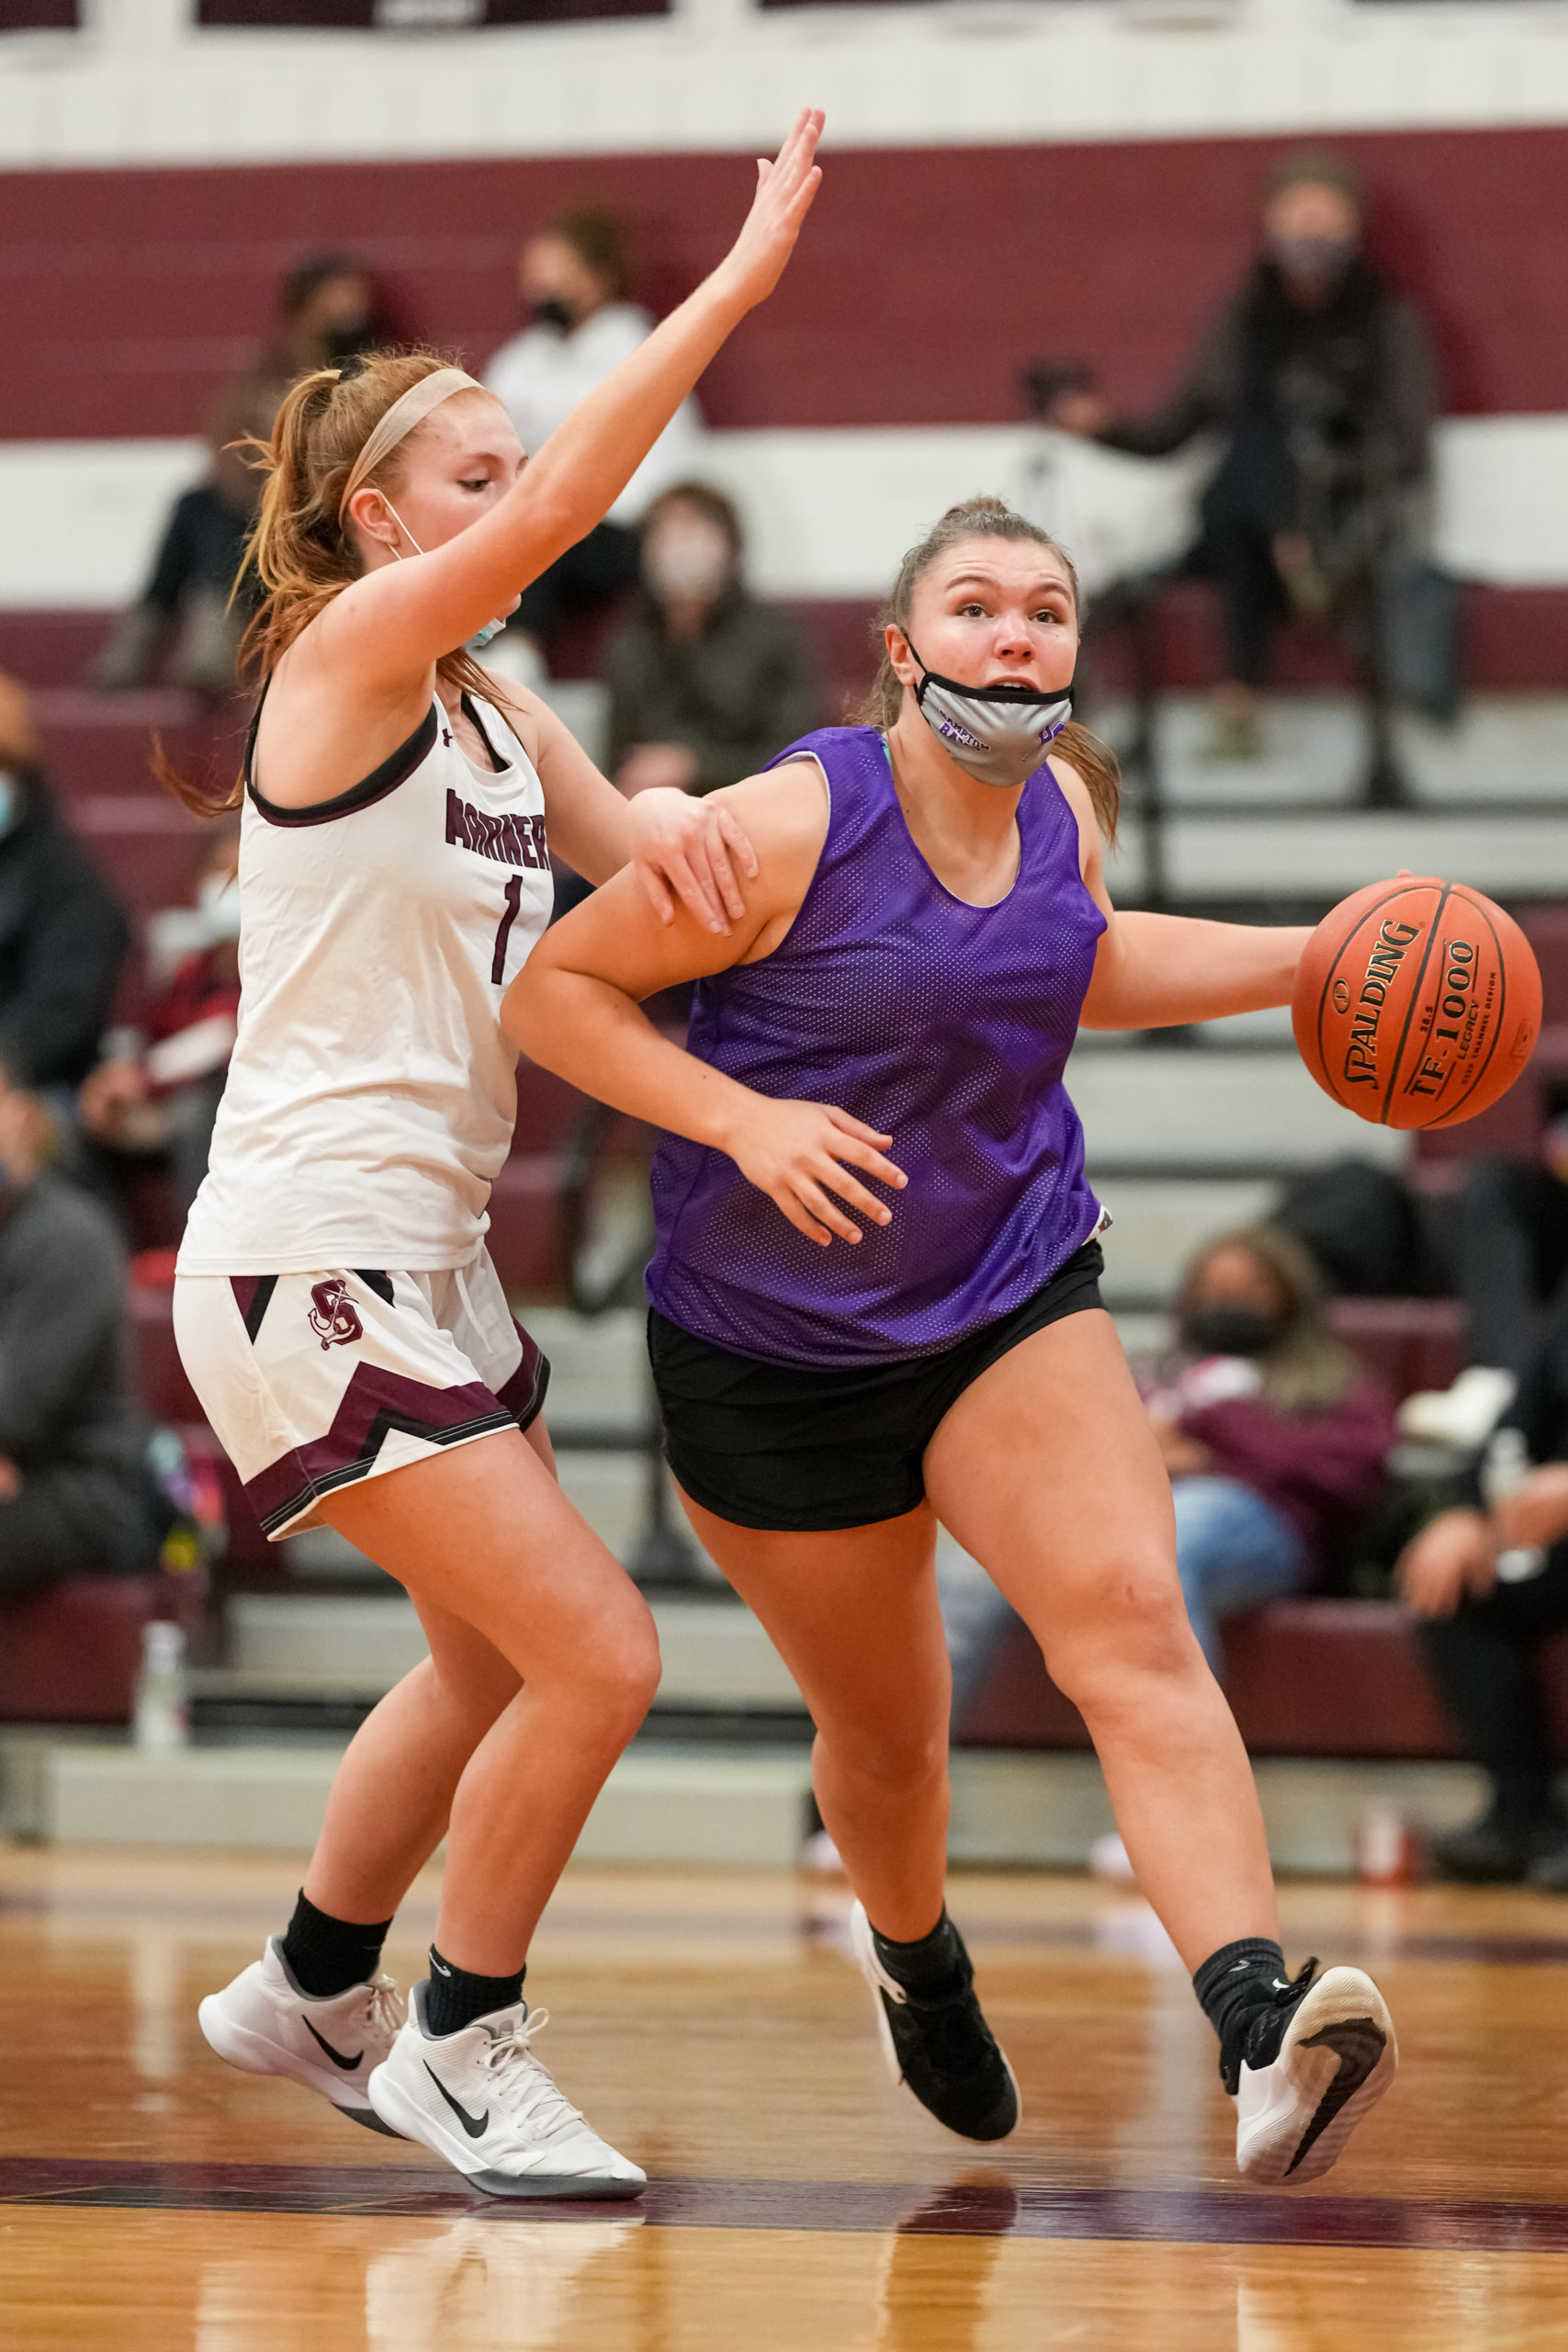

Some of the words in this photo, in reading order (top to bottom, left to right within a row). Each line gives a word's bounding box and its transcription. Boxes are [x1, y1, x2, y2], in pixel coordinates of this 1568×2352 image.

[491, 874, 524, 986] 1
[1344, 919, 1421, 1091] SPALDING
[1409, 939, 1474, 1097] TF-1000
[1419, 1006, 1434, 1033] 28.5
[1457, 999, 1480, 1061] LEGACY
[1472, 1012, 1491, 1059] CHANNEL
[1485, 971, 1497, 1010] DESIGN
